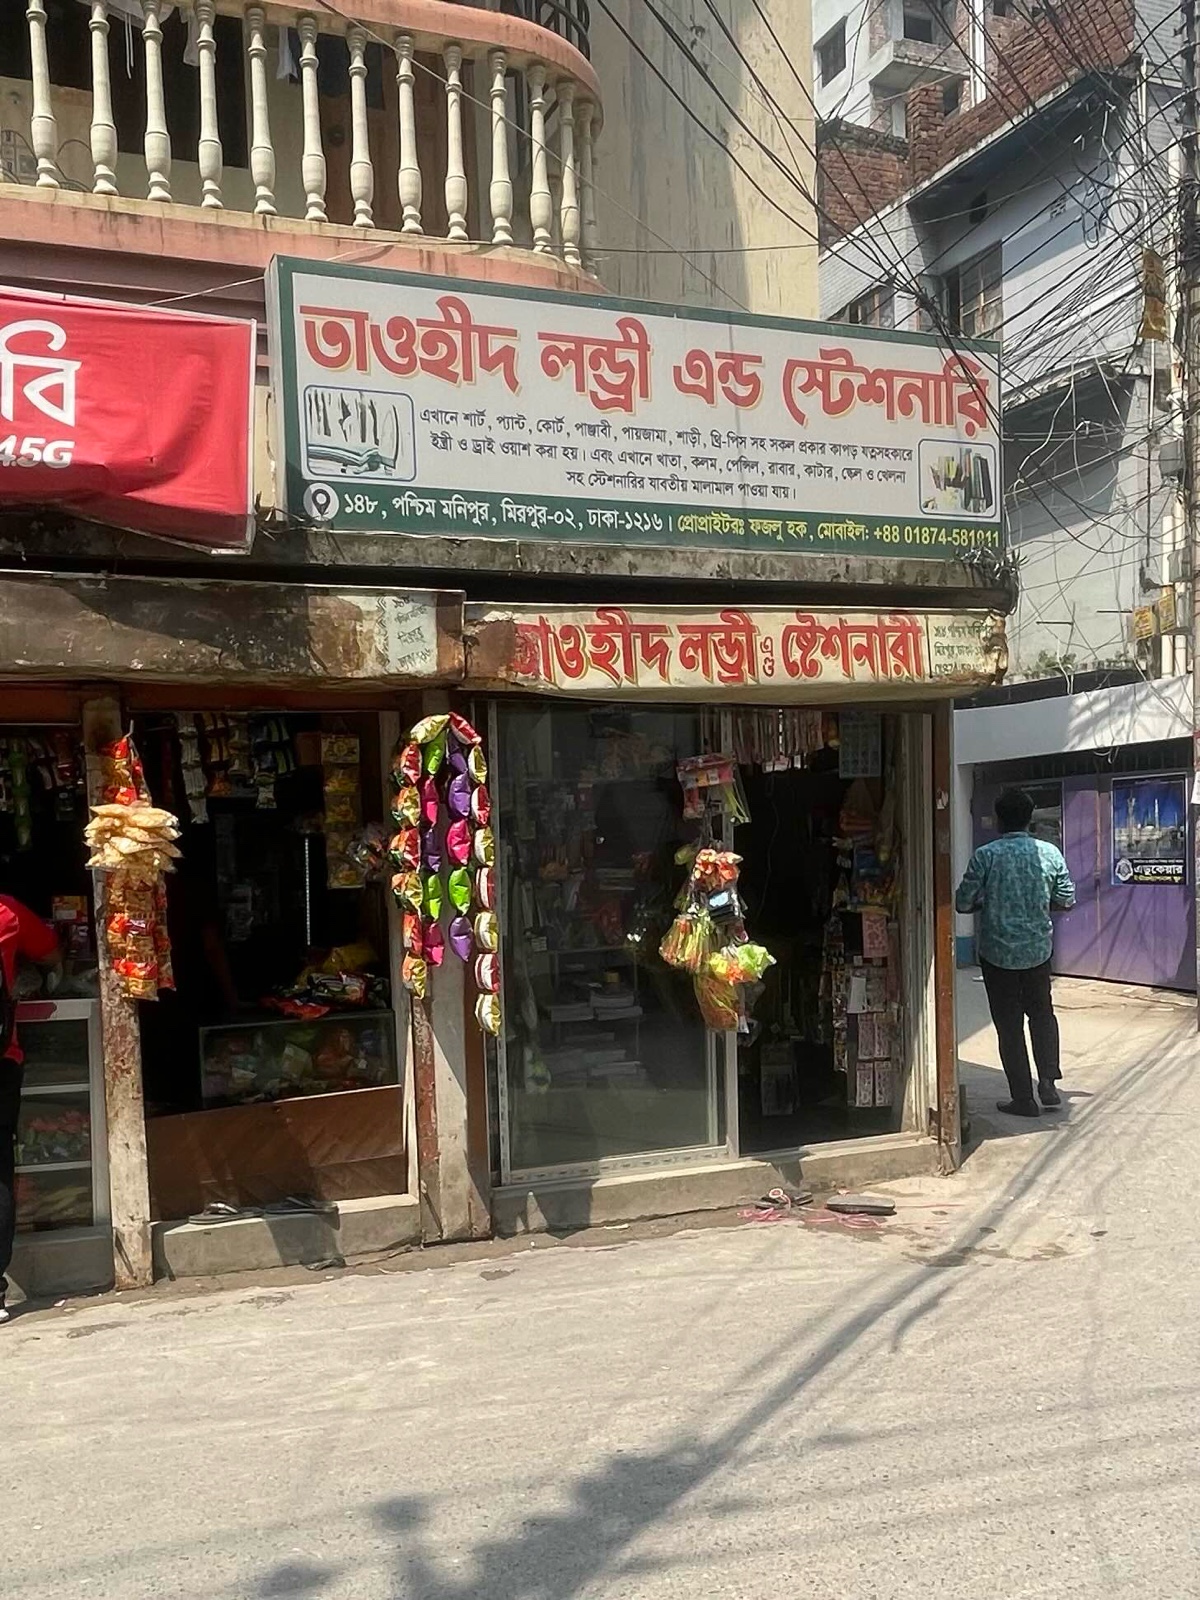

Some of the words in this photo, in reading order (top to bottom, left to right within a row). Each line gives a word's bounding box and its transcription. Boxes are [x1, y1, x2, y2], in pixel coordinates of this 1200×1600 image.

[299, 295, 521, 394] তাওহীদ
[537, 317, 653, 414] লন্ড্রী
[672, 348, 764, 409] এন্ড
[782, 347, 990, 438] স্টেশনারি
[420, 409, 459, 426] এখানে
[750, 436, 767, 452] সহ
[769, 438, 795, 453] সকল
[799, 440, 826, 455] প্রকার
[829, 442, 858, 460] কাপড়
[457, 439, 468, 451] ও
[471, 435, 496, 455] ড্রাই
[500, 441, 531, 456] ওয়াশ
[534, 444, 558, 459] করা
[591, 448, 615, 465] এবং
[618, 451, 653, 466] এখানে
[866, 470, 875, 480] ও
[877, 469, 907, 483] খেলনা
[566, 471, 585, 487] সহ
[588, 469, 645, 489] স্টেশনারির
[648, 473, 688, 492] যাবতীয়
[691, 480, 734, 496] মালামাল
[738, 483, 768, 497] পাওয়া
[392, 490, 436, 518] পশ্চিম
[749, 518, 784, 542] ফজলু
[874, 525, 900, 543] +88
